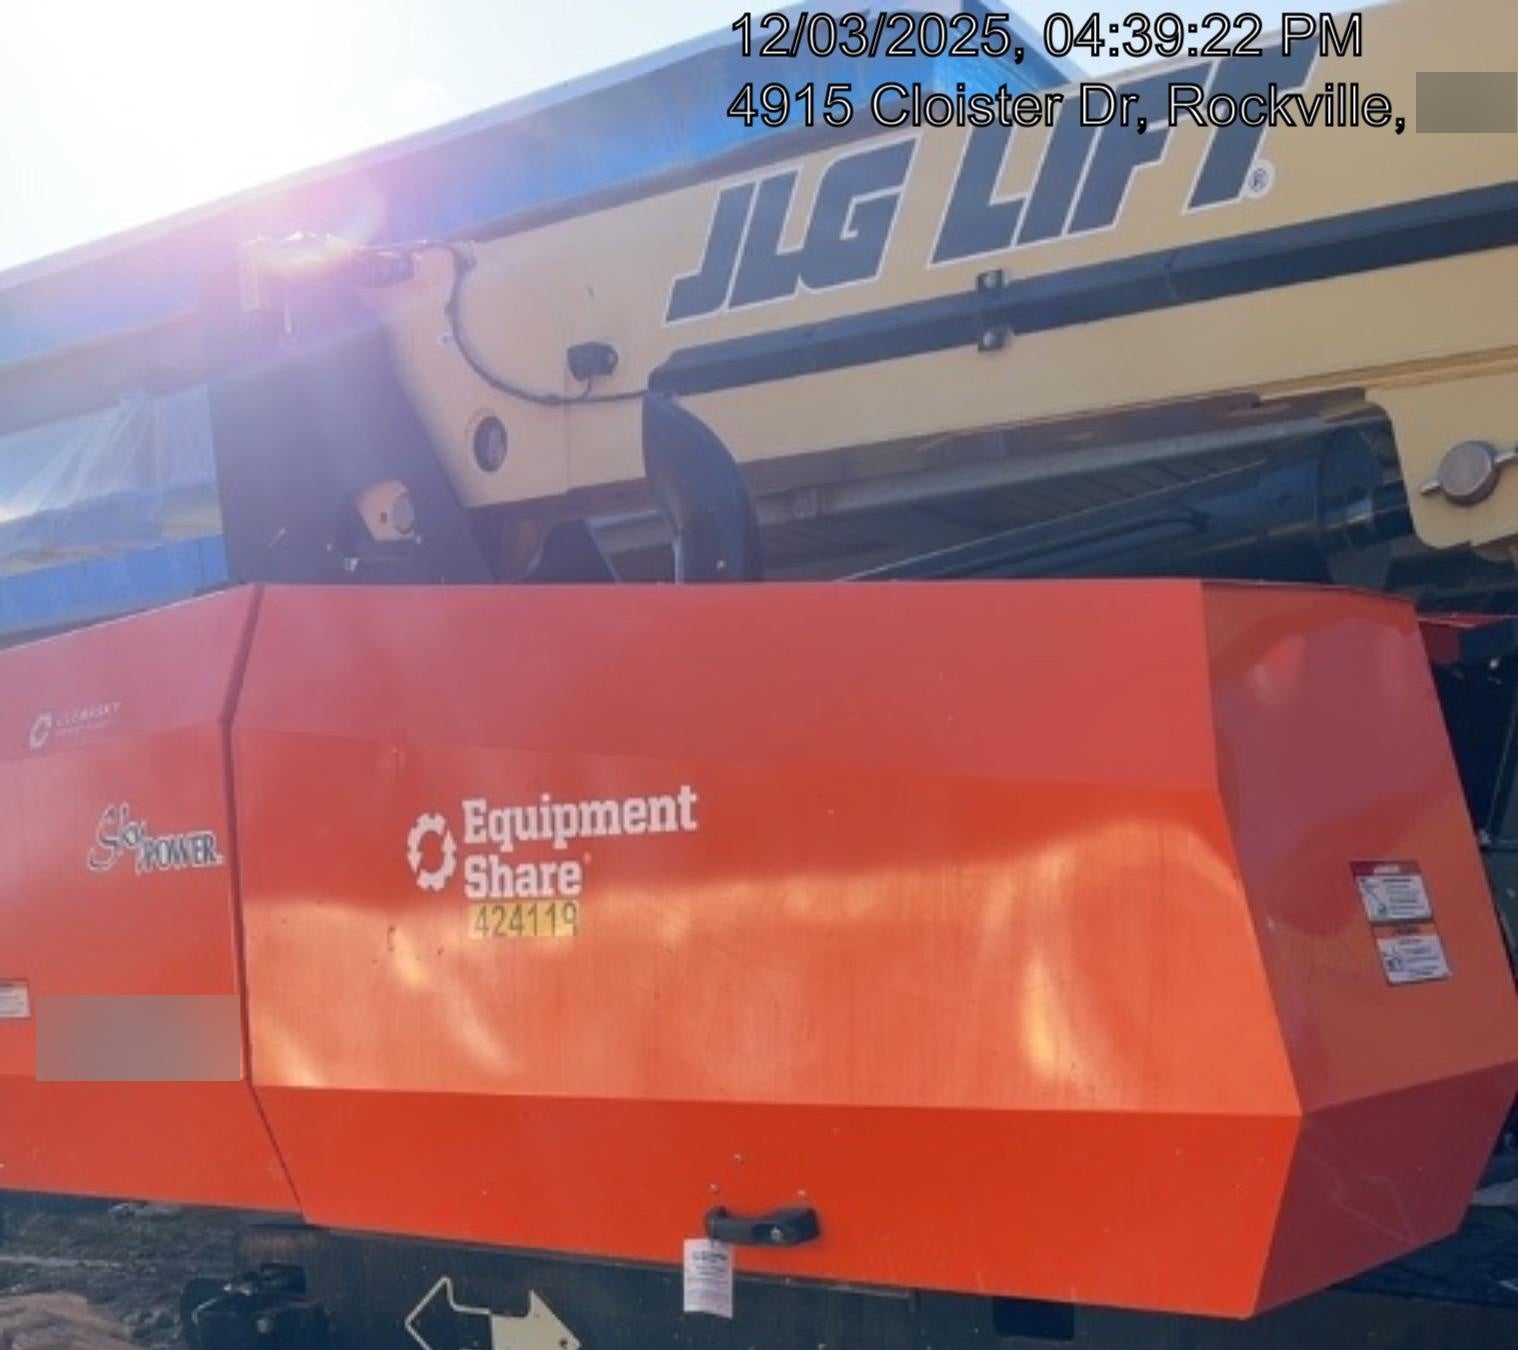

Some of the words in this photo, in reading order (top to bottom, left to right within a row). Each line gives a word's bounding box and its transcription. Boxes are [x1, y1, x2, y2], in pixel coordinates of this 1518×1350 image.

[664, 134, 923, 325] JLG
[927, 37, 1322, 269] LIFT
[463, 785, 698, 852] Equipment
[464, 855, 583, 899] Share
[474, 903, 578, 937] 424119
